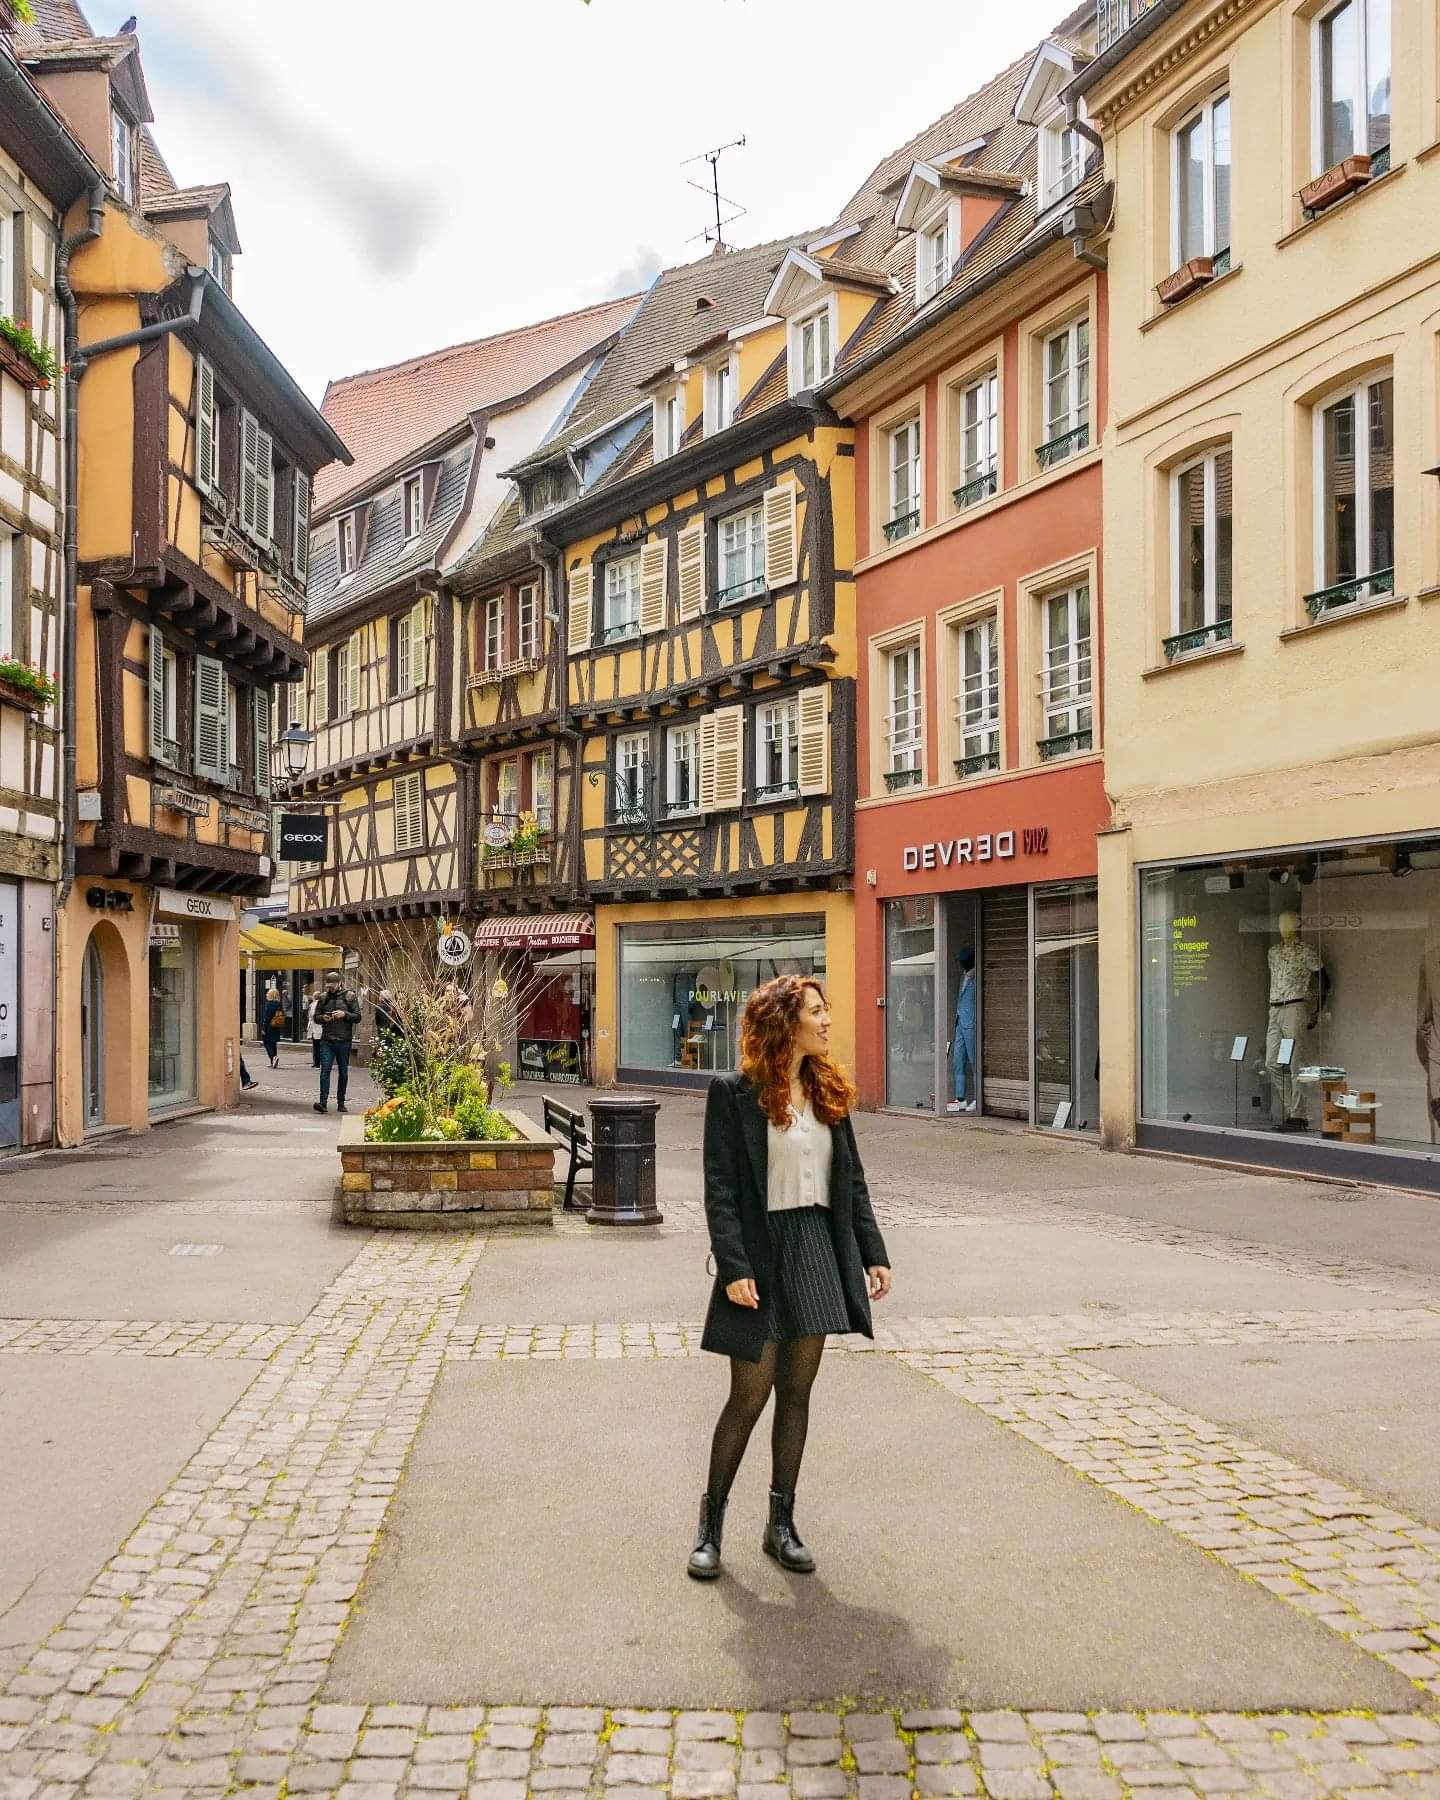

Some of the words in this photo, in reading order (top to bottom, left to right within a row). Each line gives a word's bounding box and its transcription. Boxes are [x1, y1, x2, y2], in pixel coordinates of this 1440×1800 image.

[284, 833, 324, 842] GEOX
[903, 831, 1015, 871] DEVRED
[1023, 827, 1048, 853] 1902
[186, 898, 212, 915] GEOX
[551, 935, 580, 945] BOUCHERIE
